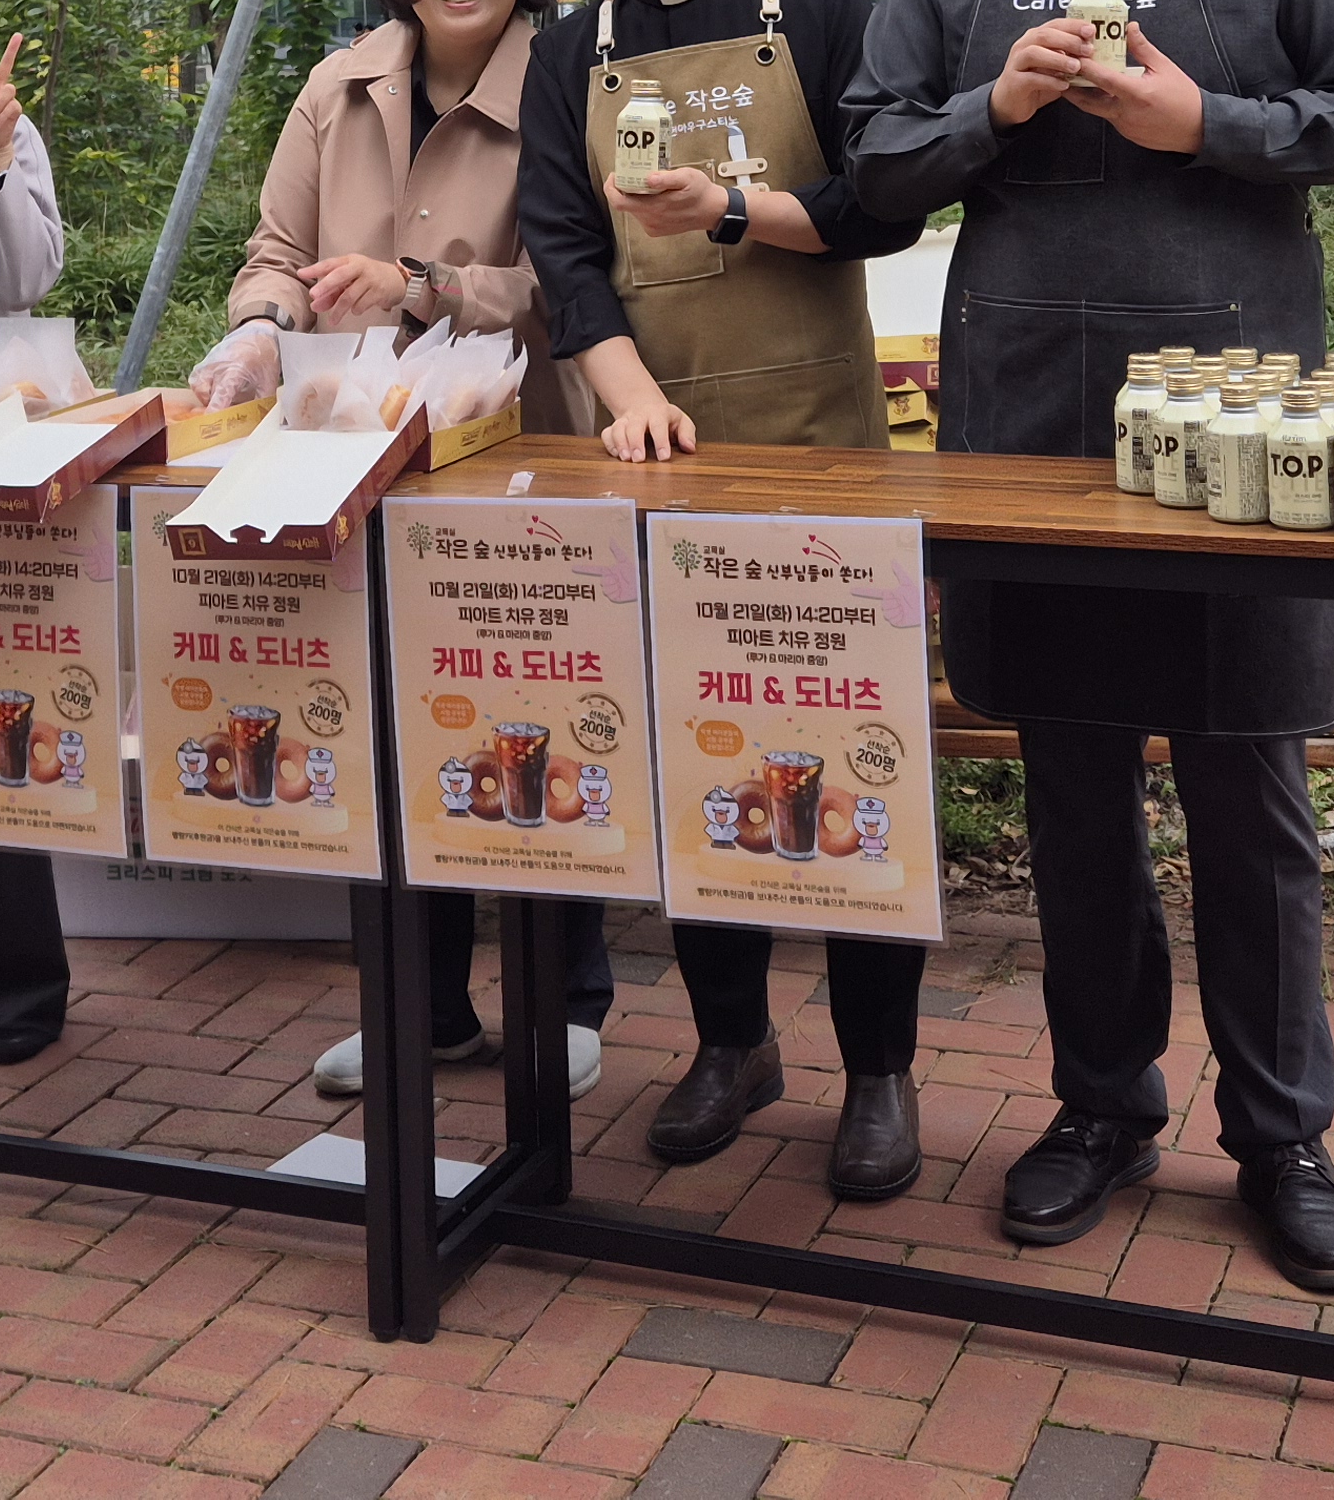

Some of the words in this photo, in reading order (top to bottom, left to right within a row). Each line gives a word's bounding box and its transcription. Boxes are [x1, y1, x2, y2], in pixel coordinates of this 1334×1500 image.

[685, 82, 755, 113] 작은숲
[617, 129, 655, 149] T.O.P
[1271, 453, 1324, 479] T.O.P
[436, 538, 469, 559] 작은
[473, 539, 490, 560] 숲
[494, 544, 556, 561] 신부님들이
[561, 545, 593, 561] 쏜다!
[14, 560, 78, 579] 14:20부터
[172, 568, 200, 585] 10월
[204, 569, 255, 587] 21일(화)
[258, 572, 326, 590] 14:20부터
[703, 557, 739, 579] 작은
[744, 558, 762, 580] 숲
[767, 564, 834, 582] 신부님들이
[839, 565, 873, 583] 쏜다!
[0, 583, 25, 599] 치유
[28, 584, 54, 601] 정원
[429, 581, 460, 598] 10월
[463, 582, 518, 600] 21일(화)
[521, 583, 596, 601] 14:20부터
[199, 593, 239, 610] 피아트
[242, 594, 270, 612] 치유
[273, 596, 301, 613] 정원
[696, 601, 729, 620] 10월
[733, 603, 792, 623] 21일(화)
[795, 605, 876, 626] 14:20부터
[458, 606, 503, 624] 피아트
[506, 607, 535, 625] 치유
[539, 608, 569, 626] 정원
[12, 623, 82, 654] 도너츠
[173, 631, 220, 663] 커피
[229, 636, 249, 663] &
[256, 636, 331, 668] 도너츠
[727, 628, 775, 647] 피아트
[778, 630, 810, 649] 치유
[814, 631, 847, 651] 정원
[432, 647, 483, 679] 커피
[492, 650, 514, 678] &
[522, 650, 603, 682] 도너츠
[59, 687, 92, 710] 200명
[698, 670, 752, 705] 커피
[763, 676, 787, 705] &
[795, 676, 882, 711] 도너츠
[308, 702, 342, 726] 200명
[578, 718, 616, 741] 200명
[855, 747, 896, 773] 200명
